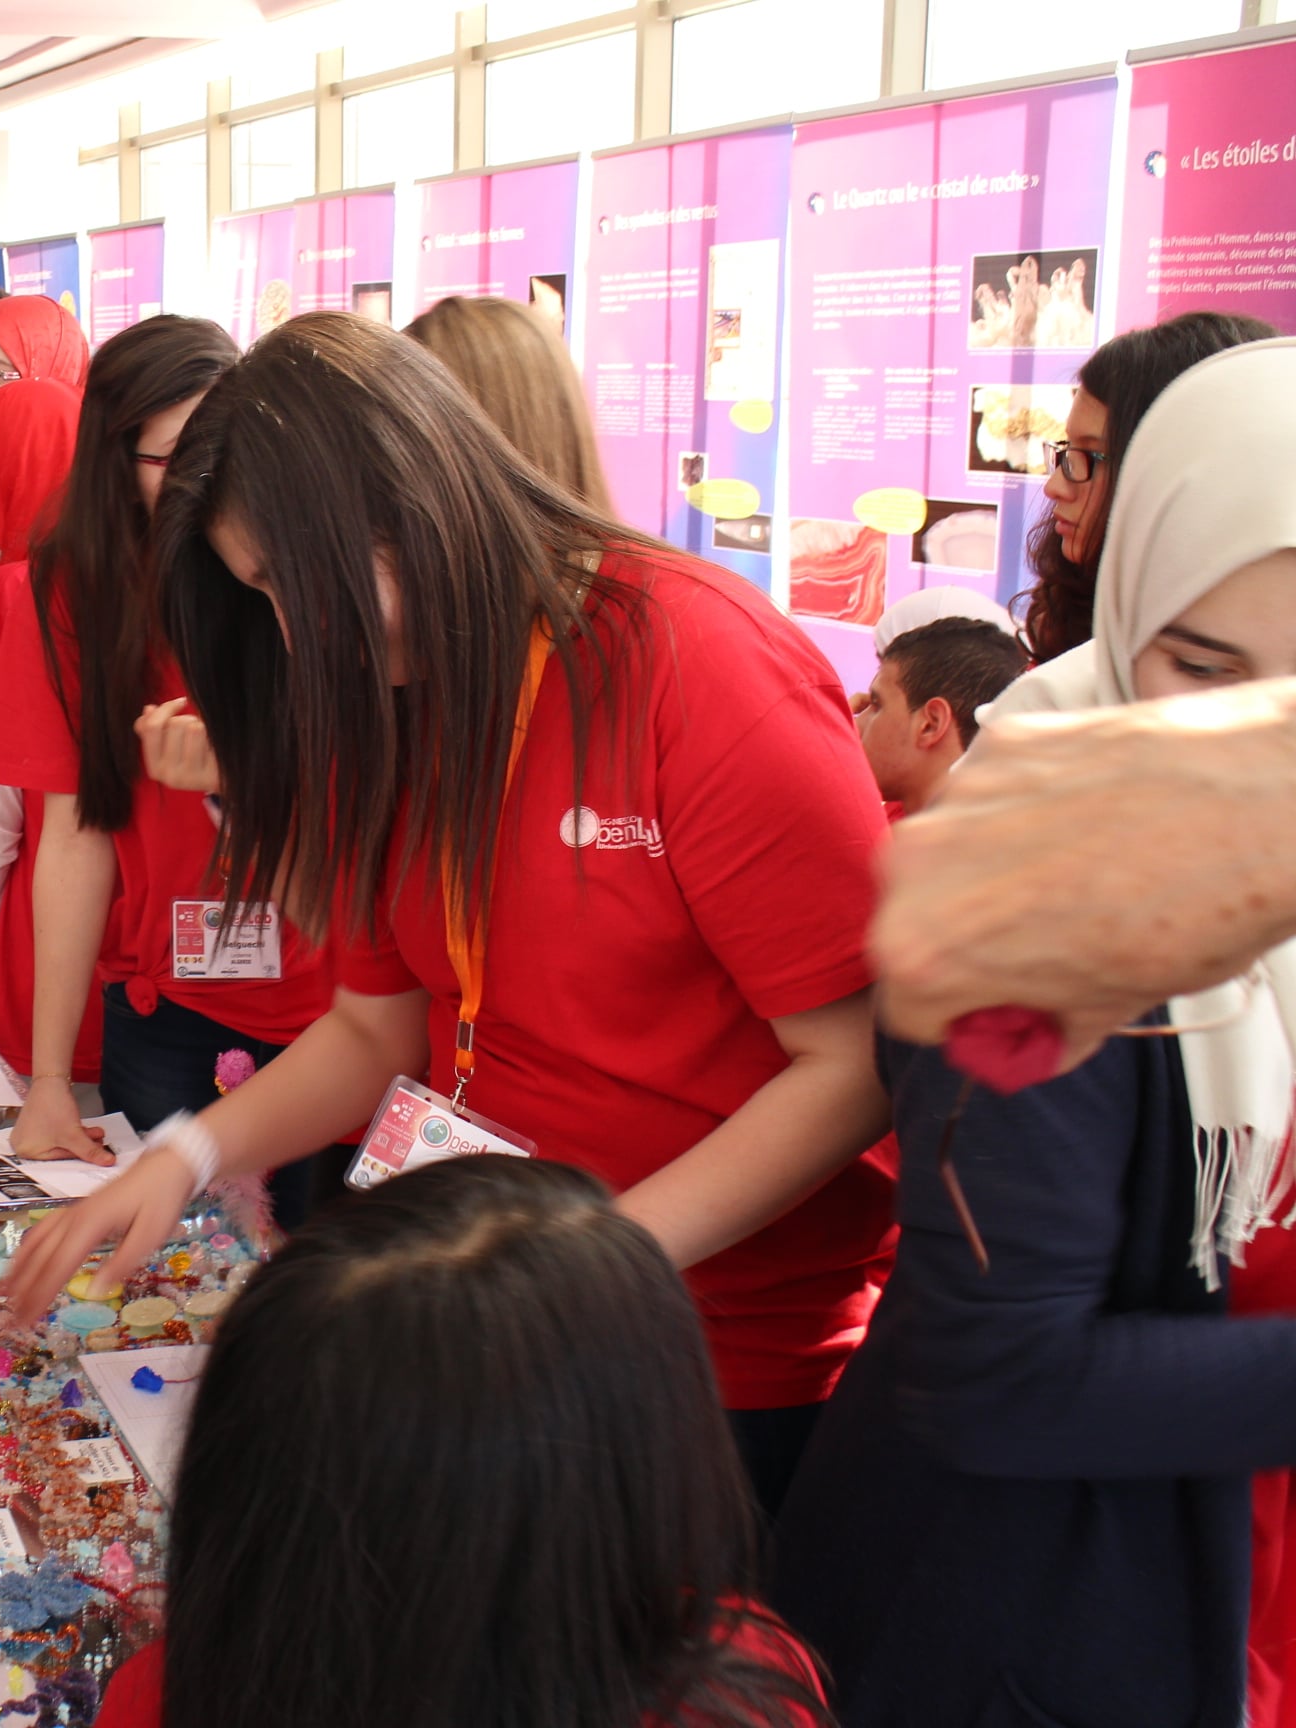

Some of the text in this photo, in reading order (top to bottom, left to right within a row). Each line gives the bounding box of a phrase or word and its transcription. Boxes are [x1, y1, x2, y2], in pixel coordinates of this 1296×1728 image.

[1194, 146, 1220, 171] Les
[1222, 139, 1280, 168] étoiles
[833, 190, 848, 210] Le
[849, 187, 889, 209] Quartz
[906, 181, 919, 202] le
[930, 175, 969, 199] cristal
[970, 173, 988, 196] de
[990, 169, 1029, 193] roche
[1253, 231, 1275, 243] dans
[1268, 246, 1284, 258] des
[1235, 263, 1276, 276] Certaines,
[1181, 281, 1215, 294] facettes,
[1215, 281, 1262, 294] provoquent
